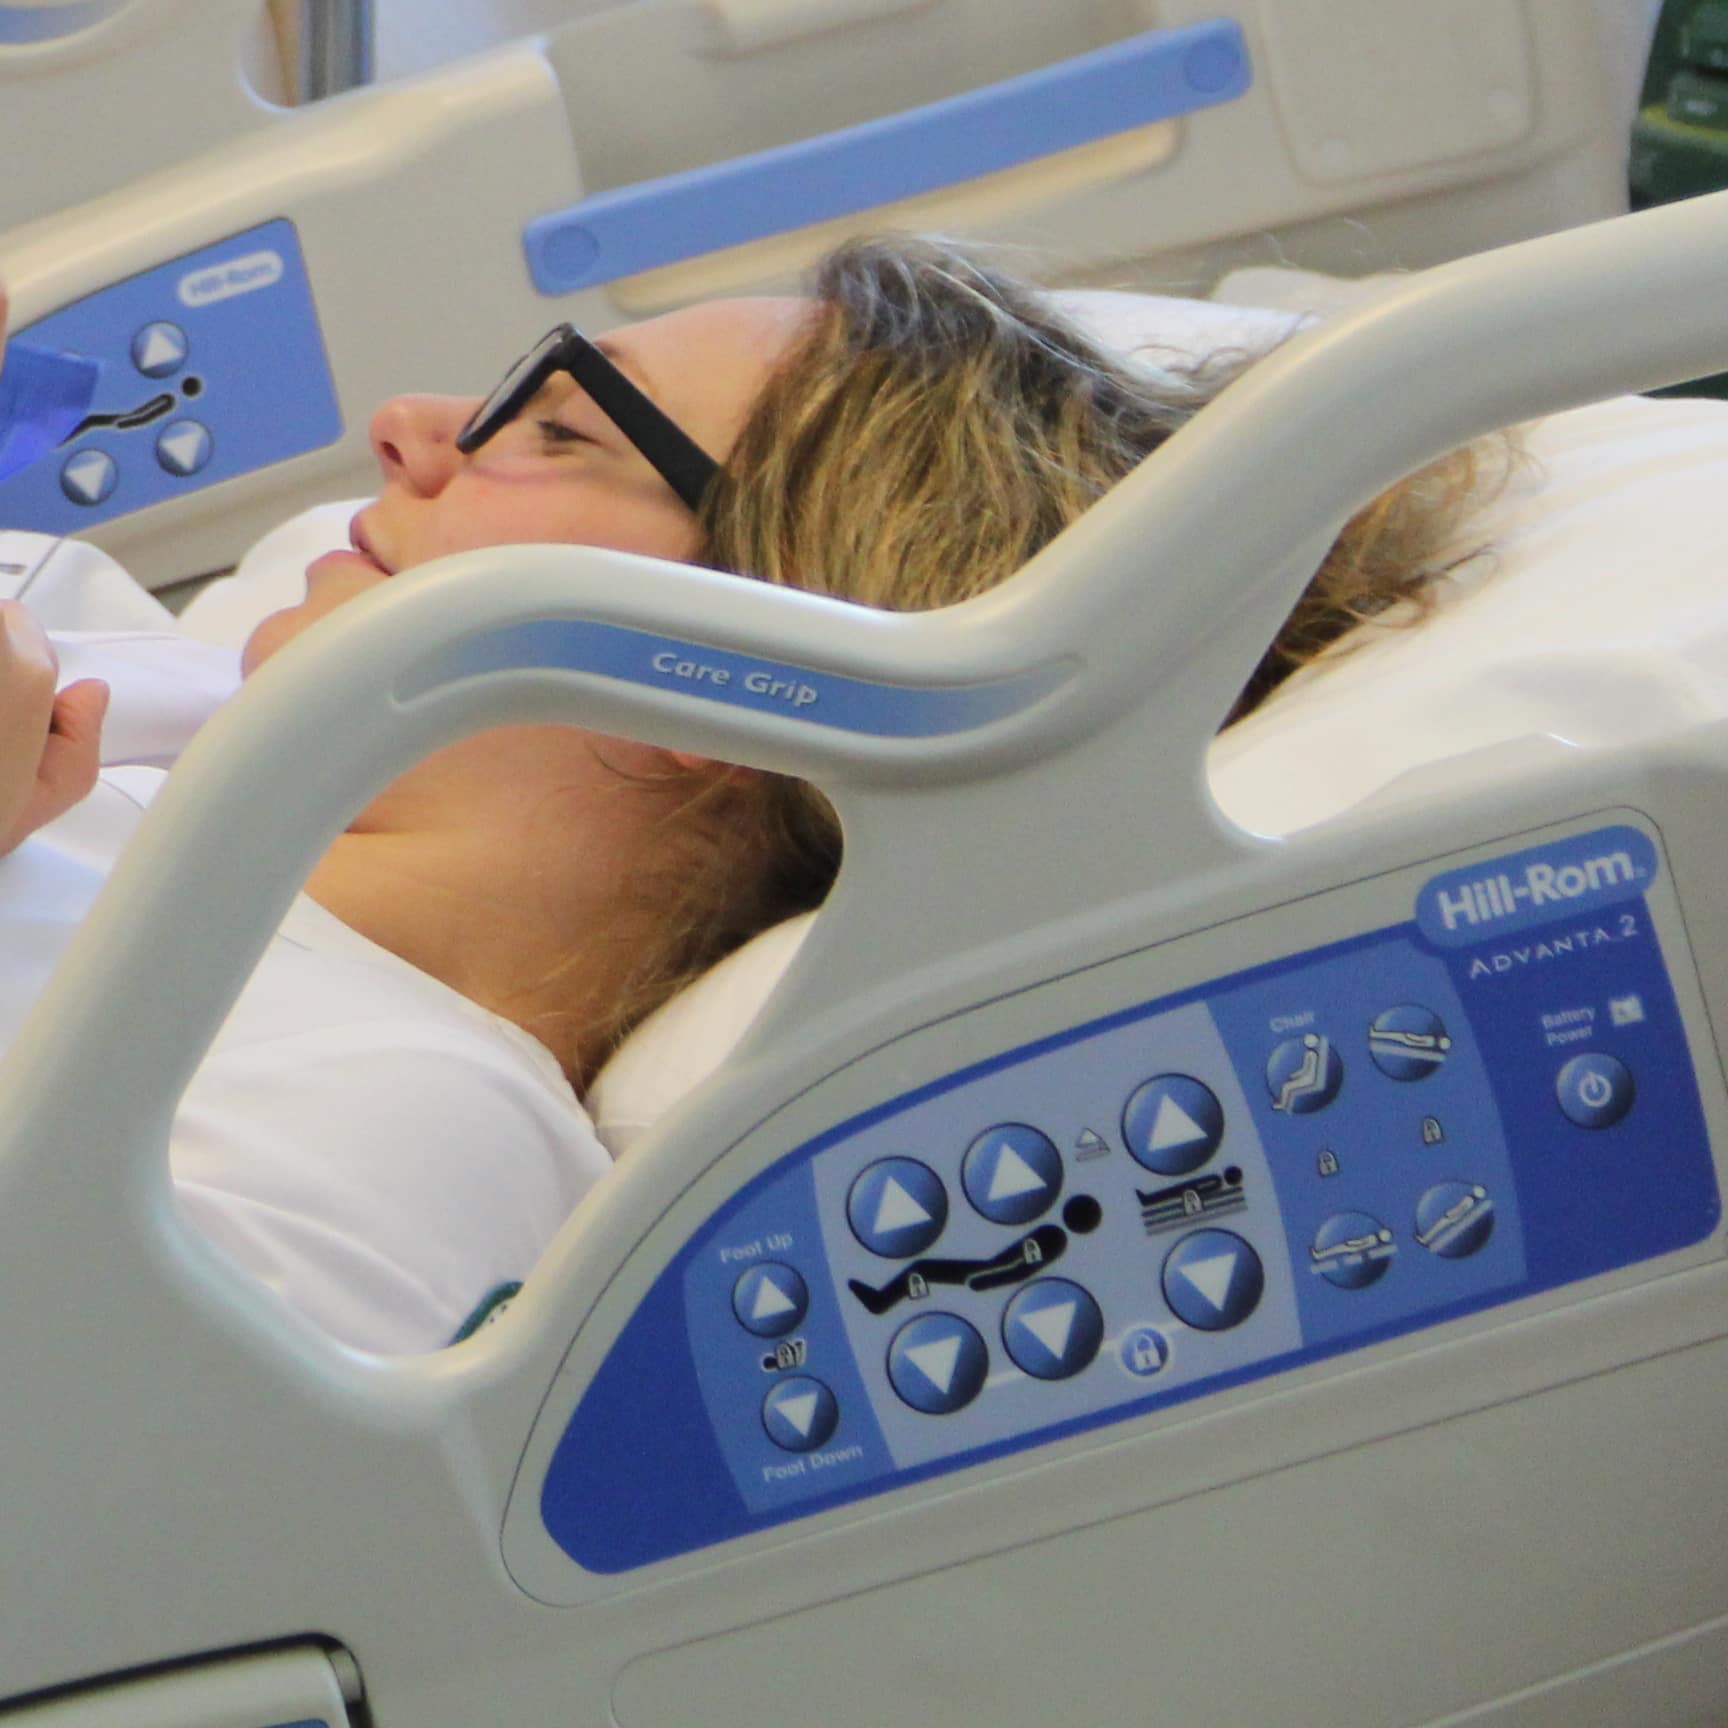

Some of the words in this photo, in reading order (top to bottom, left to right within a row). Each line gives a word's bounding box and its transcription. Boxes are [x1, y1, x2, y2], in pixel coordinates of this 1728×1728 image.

[652, 652, 730, 686] Care
[744, 672, 818, 707] Grip
[1437, 851, 1635, 930] Hill-Rom
[1469, 928, 1611, 980] ADVANTA
[1618, 915, 1639, 938] 2
[1541, 1007, 1594, 1029] Battery
[1547, 1026, 1593, 1046] Power
[720, 1240, 762, 1264] Foot
[768, 1232, 792, 1251] Up
[762, 1458, 806, 1483] Foot
[810, 1443, 864, 1470] Down
